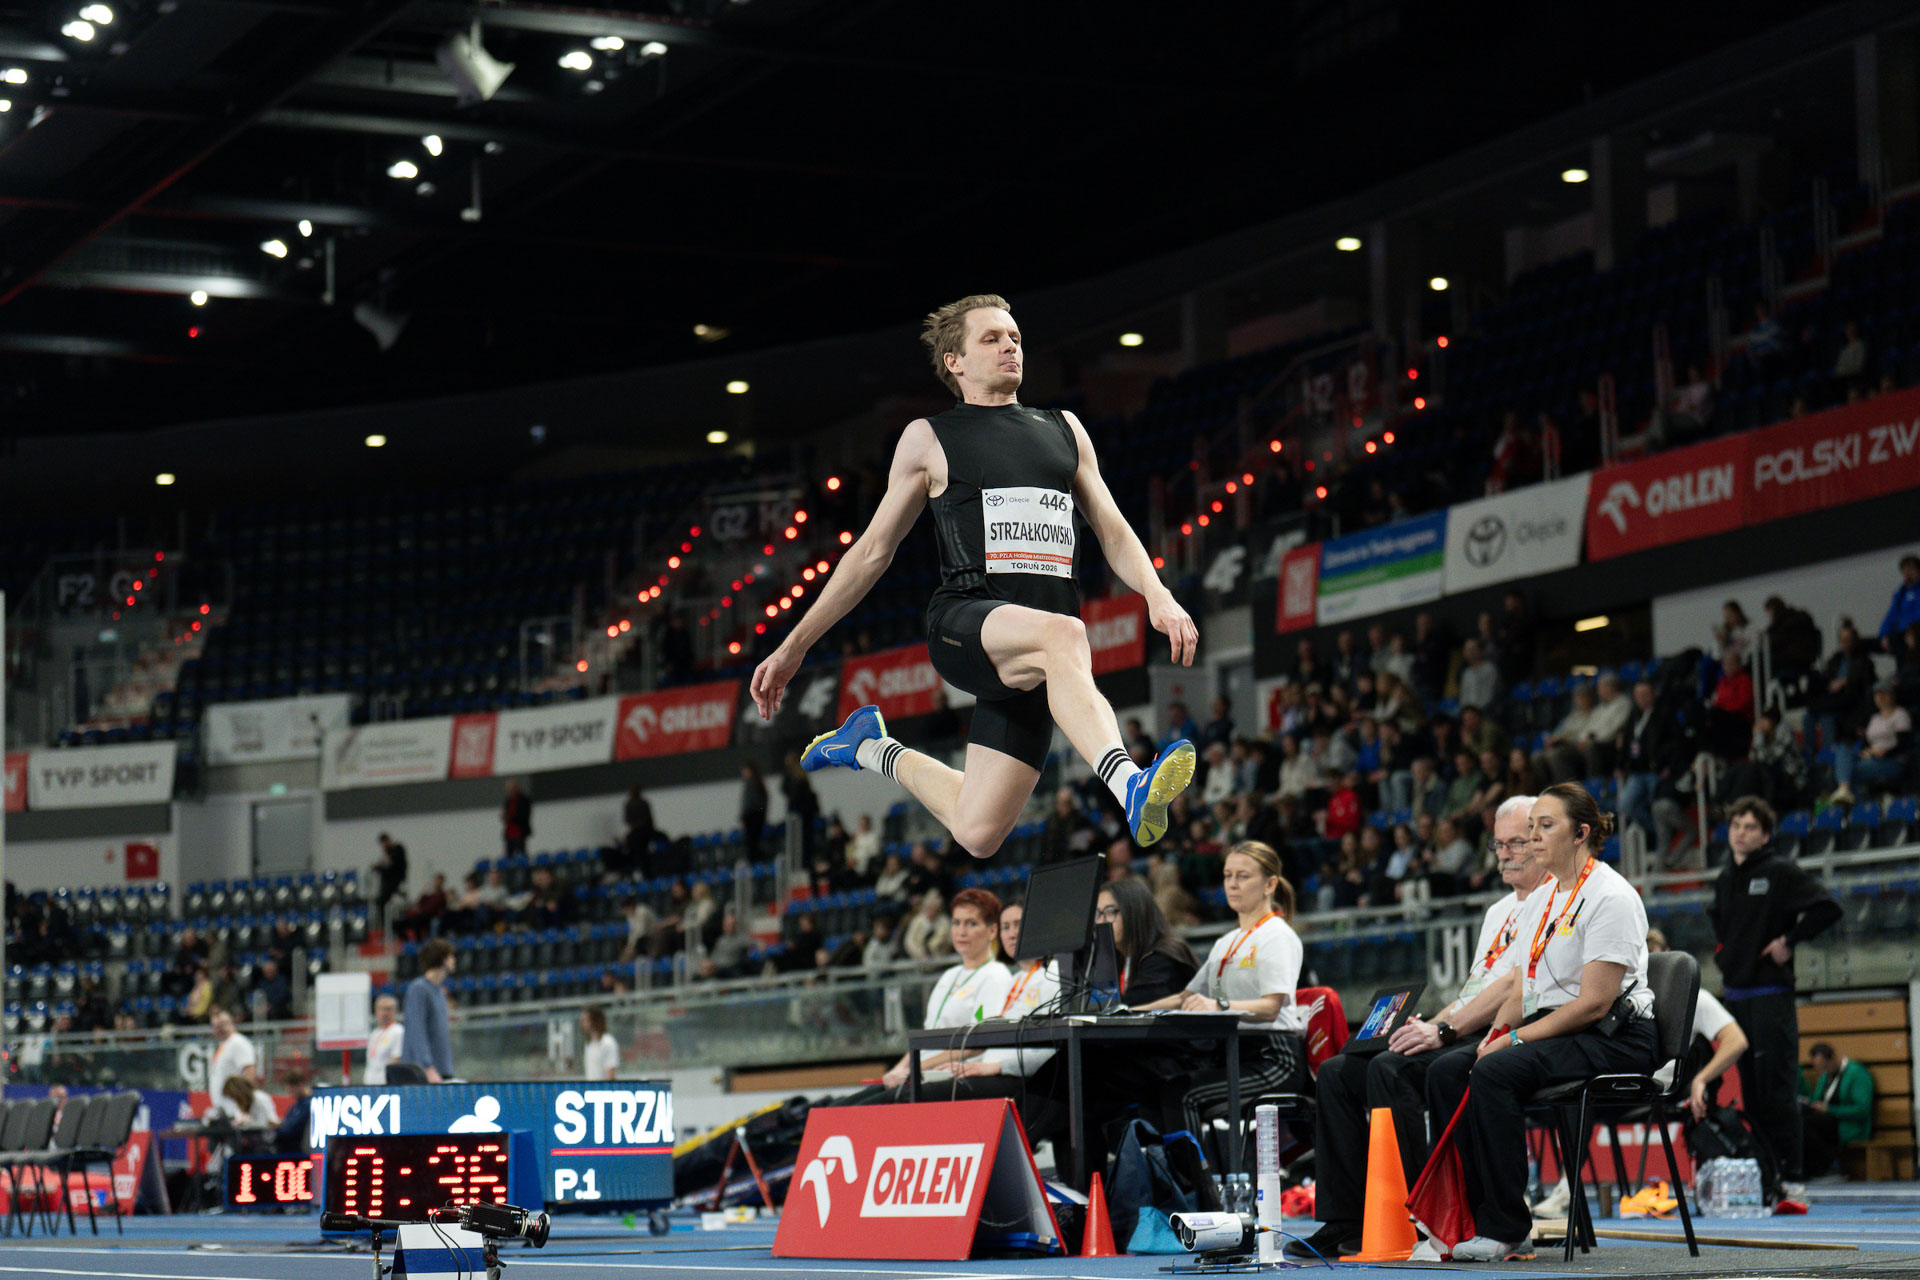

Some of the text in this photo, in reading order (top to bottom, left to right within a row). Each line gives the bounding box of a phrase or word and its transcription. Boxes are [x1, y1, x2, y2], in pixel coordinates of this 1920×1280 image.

[1755, 432, 1861, 492] POLSKI
[1039, 493, 1068, 512] 446
[1645, 463, 1735, 517] ORLEN
[990, 521, 1073, 546] STRZAŁKOWSKI
[1011, 561, 1058, 573] TORUŃ 2026
[876, 661, 942, 698] ORLEN
[660, 701, 730, 734] ORLEN
[509, 729, 546, 752] TVP
[550, 720, 606, 750] SPORT
[42, 766, 84, 790] TVP
[88, 762, 158, 788] SPORT
[345, 1144, 507, 1216] 0:36
[554, 1168, 602, 1200] P.1
[872, 1155, 974, 1207] ORLEN
